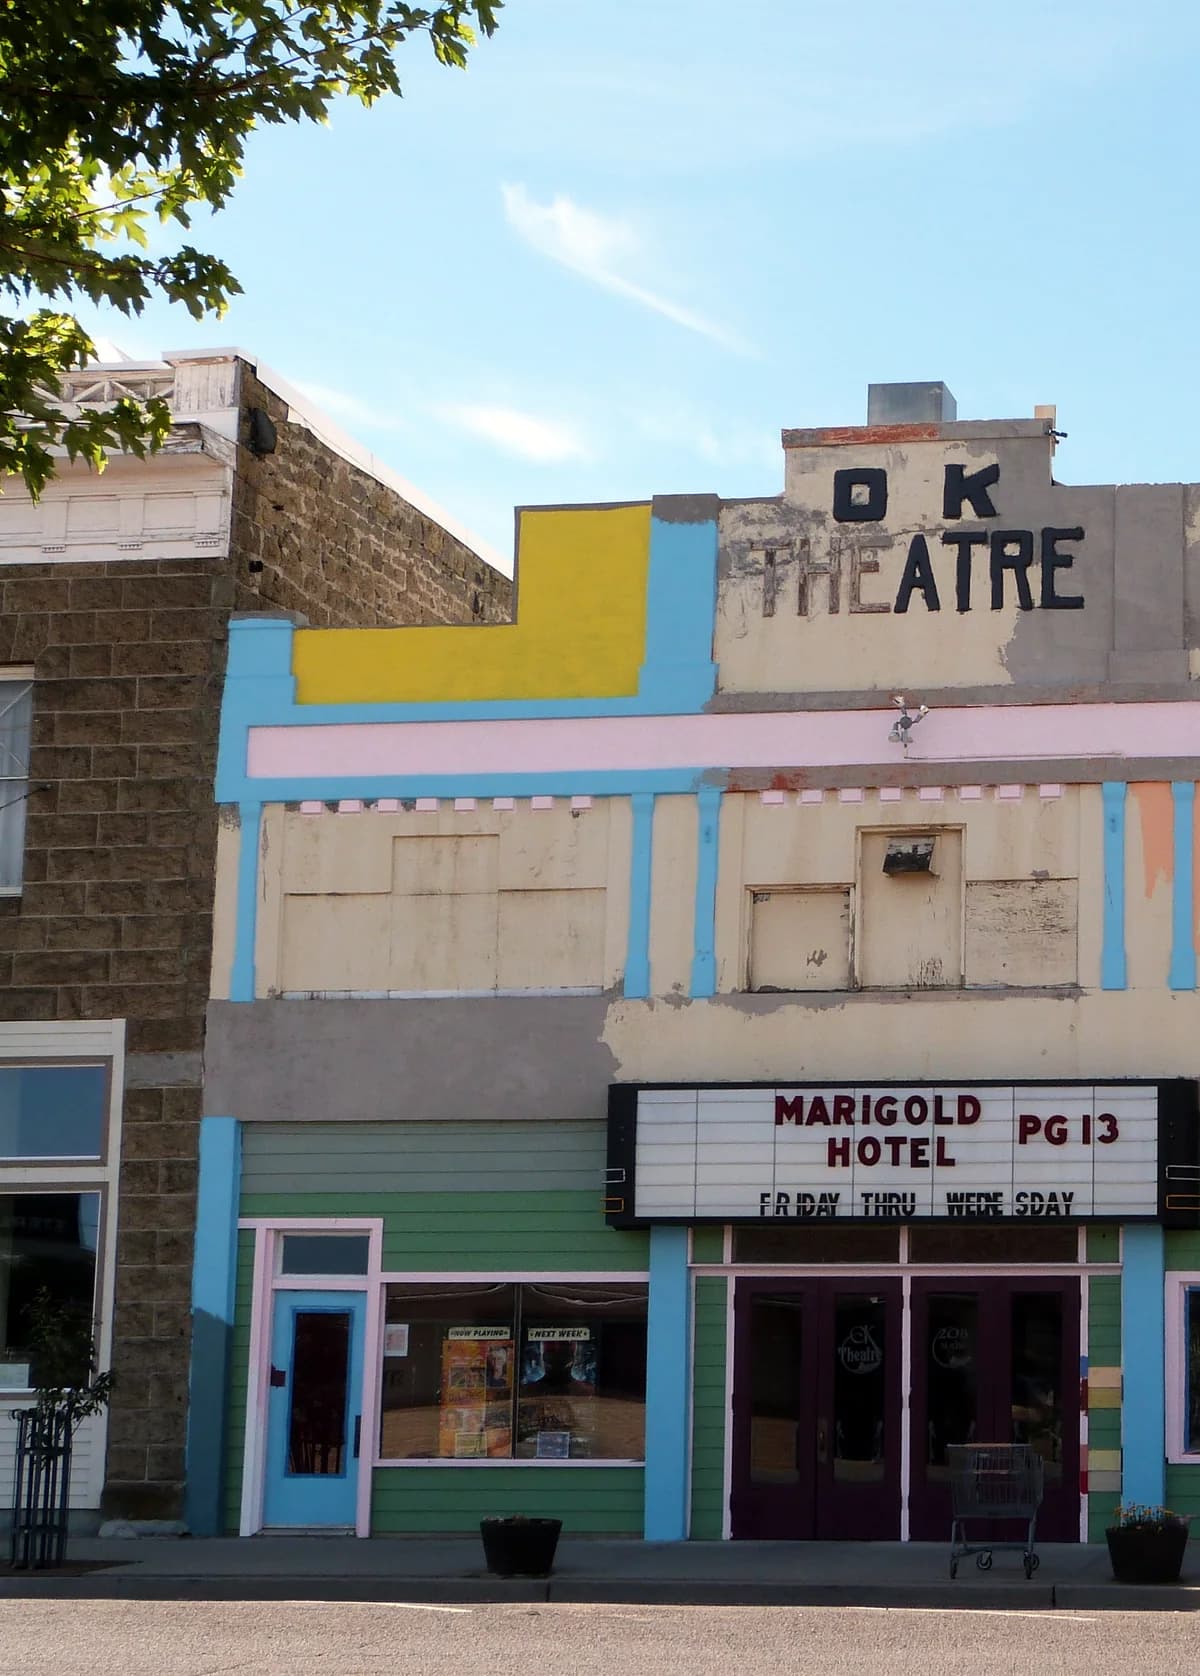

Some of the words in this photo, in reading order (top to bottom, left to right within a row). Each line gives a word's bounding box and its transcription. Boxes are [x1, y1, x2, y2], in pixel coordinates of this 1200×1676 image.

[750, 526, 1085, 618] THEATRE
[775, 1095, 981, 1126] MARIGOLD
[827, 1136, 956, 1168] HOTEL
[760, 1192, 840, 1217] FRIDAY
[861, 1192, 915, 1217] THRU
[474, 1329, 504, 1337] PLAYING
[534, 1330, 556, 1338] NEXT
[559, 1330, 583, 1338] WEEK
